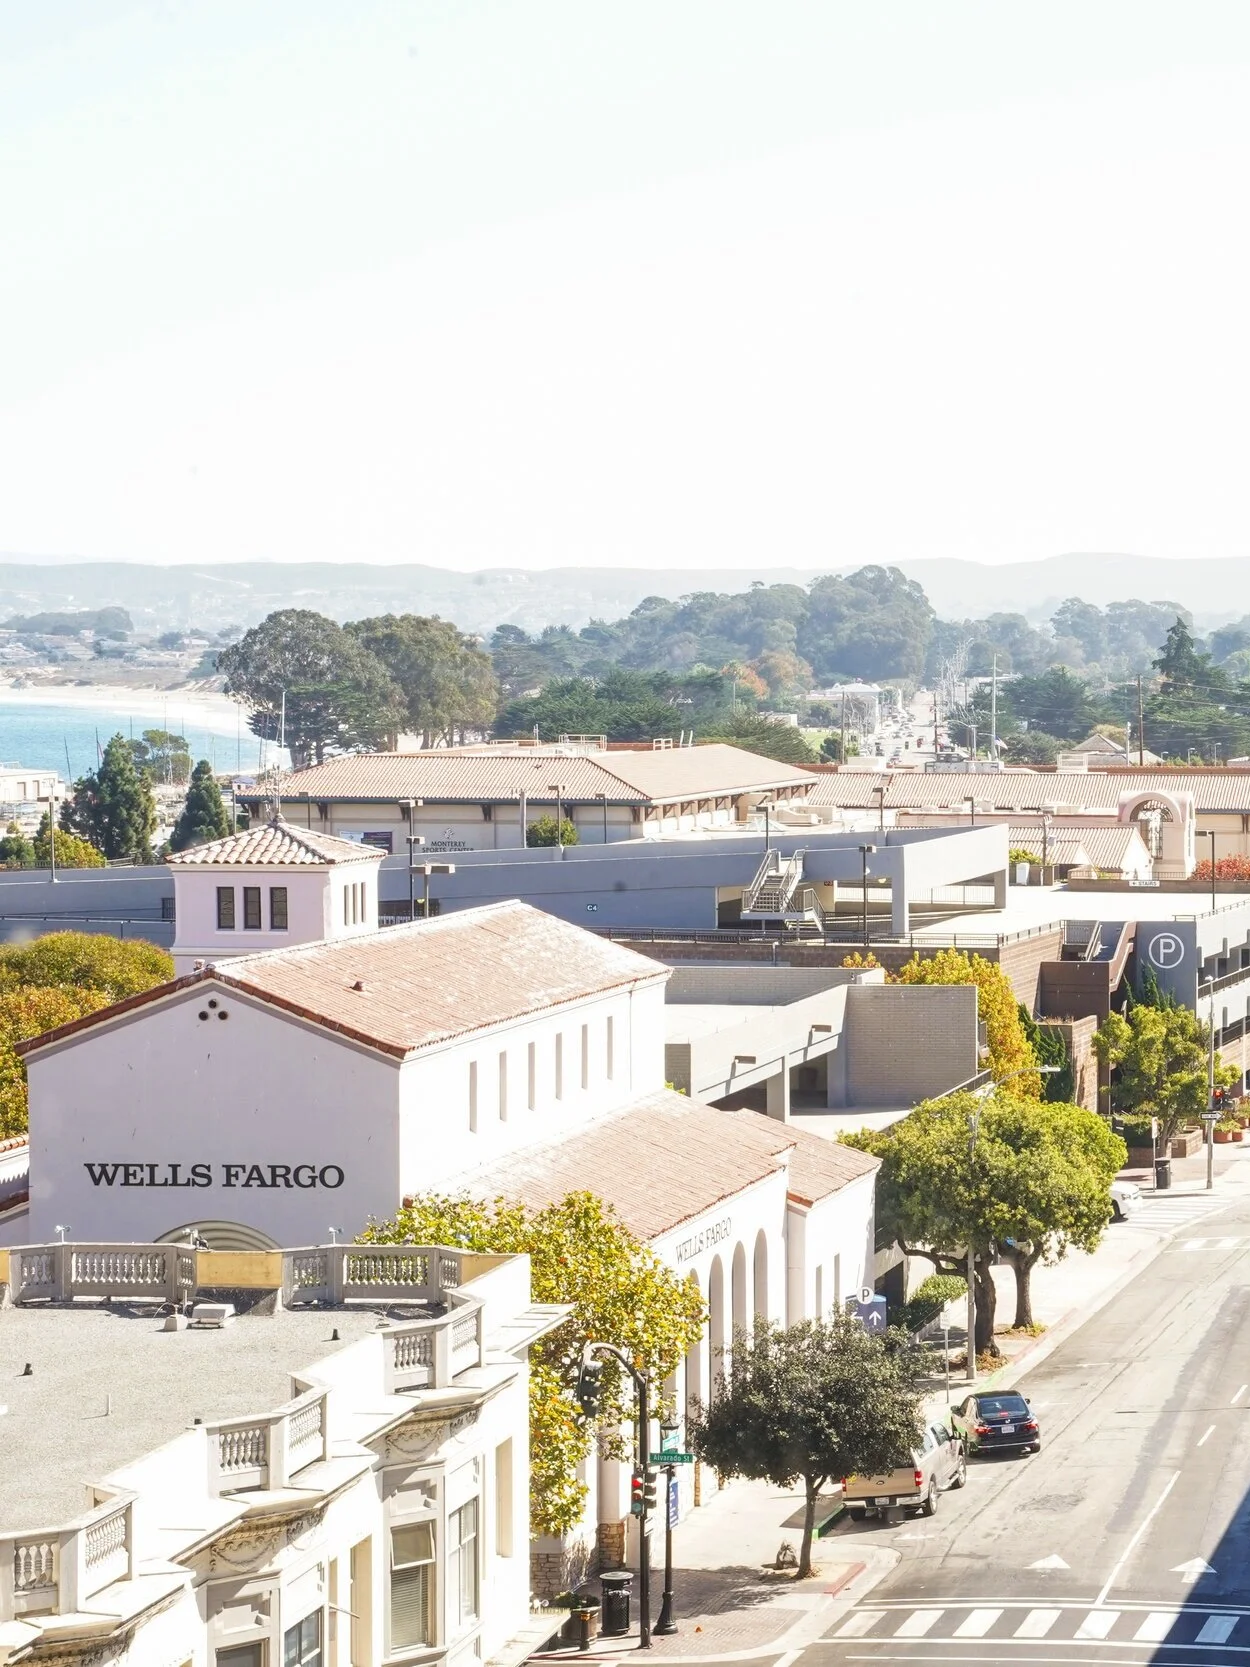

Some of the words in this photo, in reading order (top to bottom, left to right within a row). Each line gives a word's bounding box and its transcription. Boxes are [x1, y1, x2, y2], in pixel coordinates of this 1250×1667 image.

[1159, 938, 1176, 964] P
[84, 1163, 213, 1188] WELLS
[221, 1163, 345, 1189] FARGO
[675, 1231, 704, 1265] WELLS
[705, 1217, 732, 1249] FARGO
[861, 1288, 870, 1302] P
[653, 1454, 682, 1462] Alvarado
